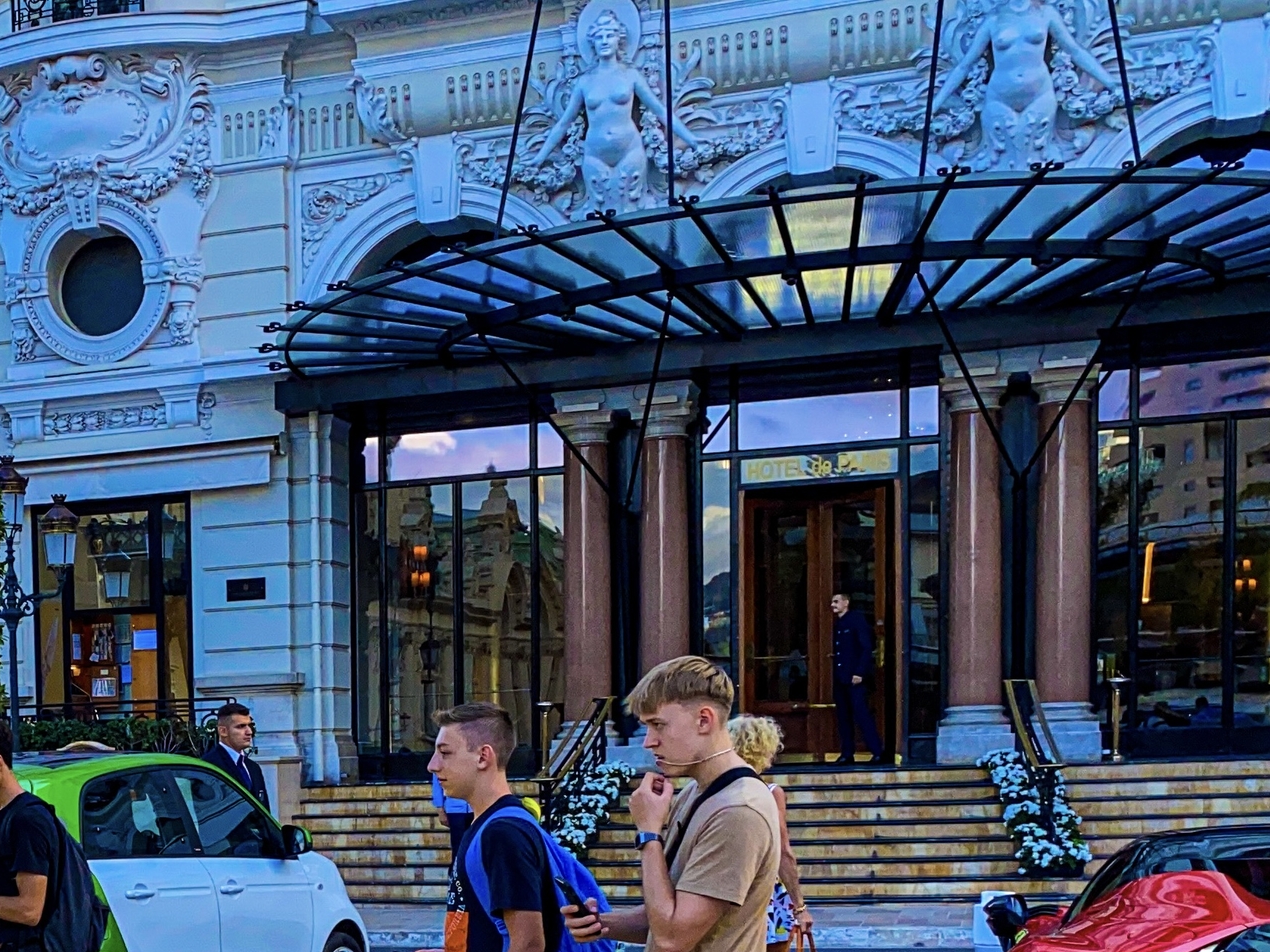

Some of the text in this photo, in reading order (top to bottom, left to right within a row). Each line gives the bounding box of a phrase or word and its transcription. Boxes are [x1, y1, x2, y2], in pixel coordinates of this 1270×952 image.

[746, 450, 891, 481] HOTEL de PARIS
